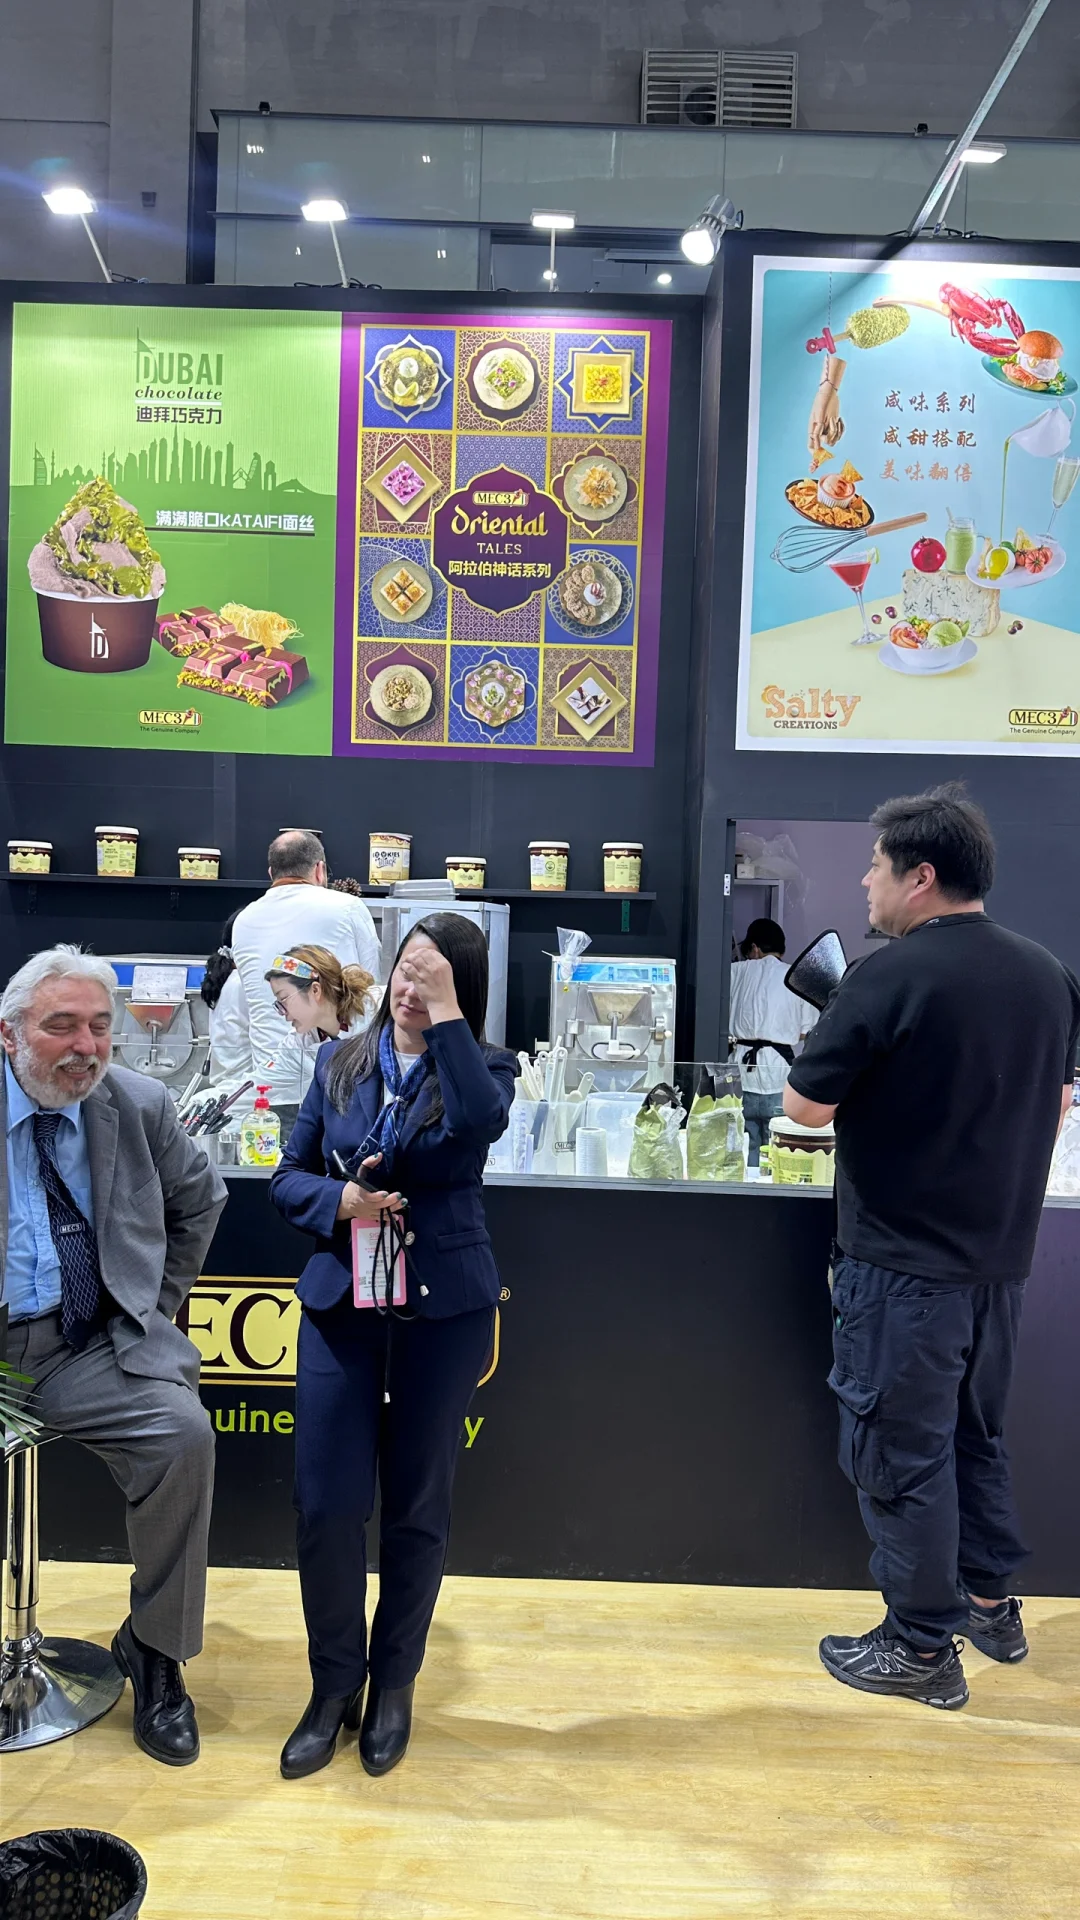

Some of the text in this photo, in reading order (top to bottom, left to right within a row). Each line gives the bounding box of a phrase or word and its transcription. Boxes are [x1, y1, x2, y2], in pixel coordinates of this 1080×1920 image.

[136, 341, 223, 386] DUBAI
[135, 385, 222, 400] chocolate
[885, 390, 976, 413] 咸味系列
[136, 406, 222, 424] 迪拜巧克力
[883, 425, 977, 448] 咸甜搭配
[880, 459, 972, 482] 美味翻倍
[477, 493, 512, 504] MEC3
[155, 510, 315, 531] 满满脆口KATAIFI面丝
[451, 504, 549, 536] Oriental
[476, 543, 522, 555] TALES
[448, 560, 552, 578] 阿拉伯神话系列
[763, 686, 861, 727] Salty
[144, 711, 183, 724] MEC3
[773, 720, 838, 730] CREATIONS
[1014, 711, 1057, 725] MEC3
[175, 1292, 294, 1370] EC
[206, 1402, 295, 1434] uine
